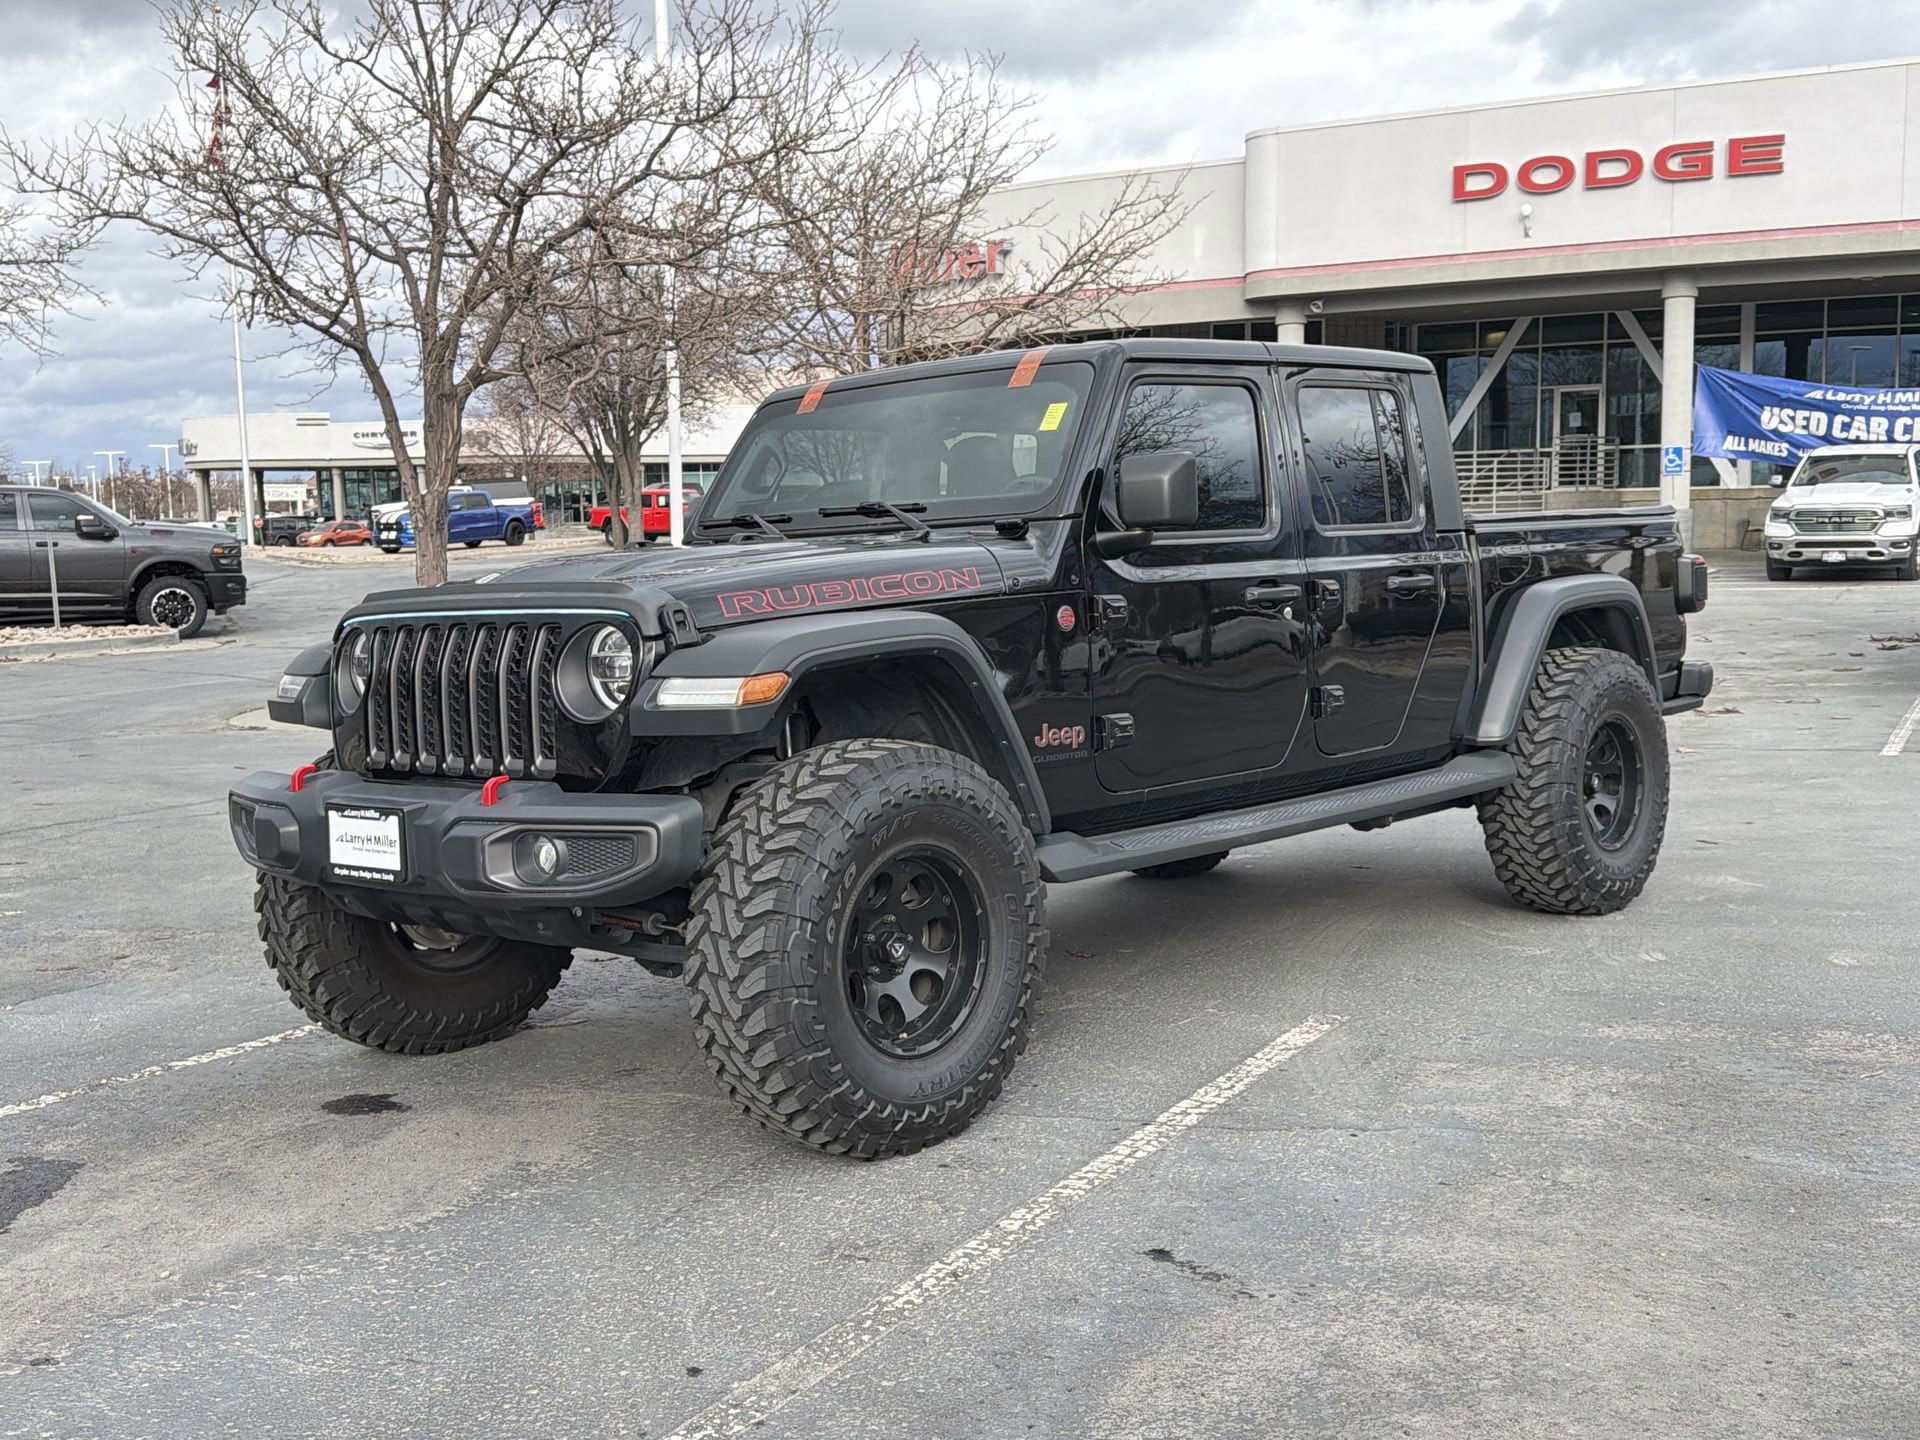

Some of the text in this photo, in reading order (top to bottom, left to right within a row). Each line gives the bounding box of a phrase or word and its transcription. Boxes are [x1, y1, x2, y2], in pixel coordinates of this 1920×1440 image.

[1452, 134, 1785, 202] DODGE
[1826, 389, 1875, 405] Larry
[1880, 391, 1892, 405] H
[1760, 406, 1828, 437] USED
[1832, 414, 1889, 442] CAR
[353, 431, 417, 439] CHRYER
[1722, 435, 1747, 451] ALL
[1749, 438, 1790, 457] MAKES
[1816, 516, 1854, 524] RAM
[717, 566, 981, 618] RUBICON
[1034, 722, 1086, 749] Jeep
[1032, 751, 1088, 763] GLADIATOR
[345, 832, 397, 848] Larry H Miller
